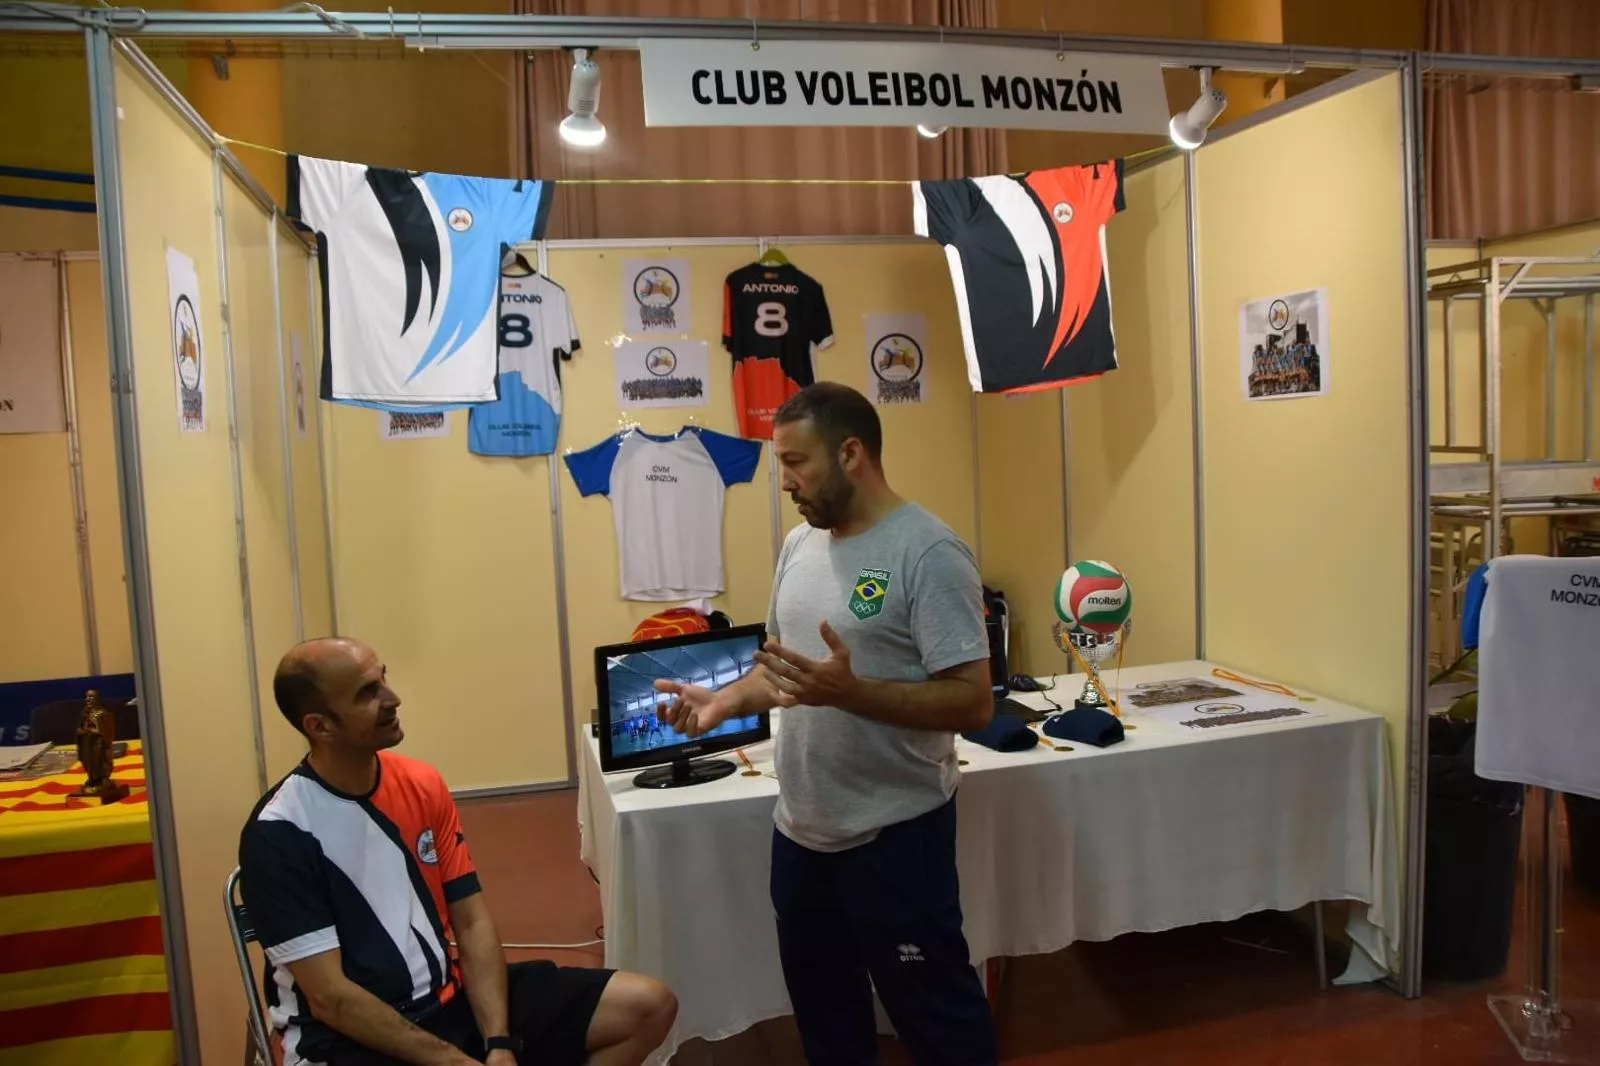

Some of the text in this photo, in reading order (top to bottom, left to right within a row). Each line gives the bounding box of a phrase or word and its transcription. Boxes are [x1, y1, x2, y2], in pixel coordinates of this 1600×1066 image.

[692, 69, 1122, 114] CLUB VOLEIBOL MONZÓN
[742, 283, 800, 295] ANTONIO
[754, 301, 789, 338] 8
[500, 313, 533, 348] 8
[652, 465, 670, 474] CVM
[859, 570, 889, 581] BRASIL
[1088, 596, 1122, 606] molten
